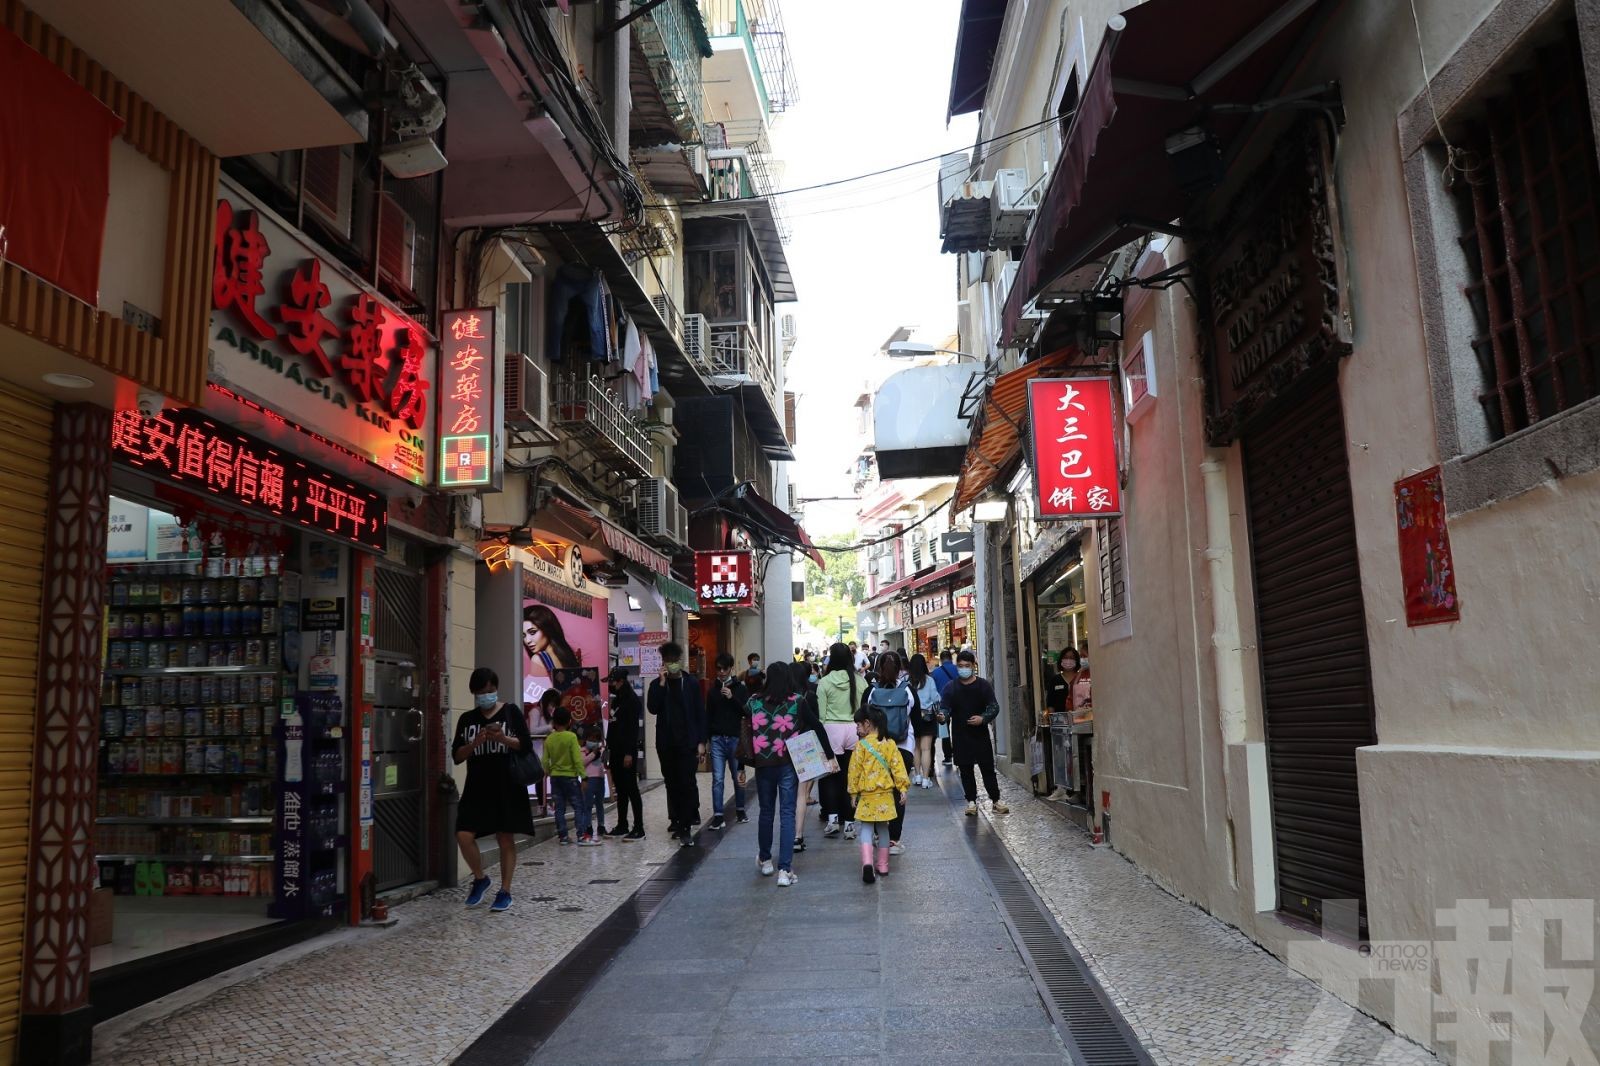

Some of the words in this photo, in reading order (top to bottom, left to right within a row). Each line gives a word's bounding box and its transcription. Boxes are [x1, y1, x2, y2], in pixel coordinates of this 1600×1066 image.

[208, 318, 347, 409] ARMÁCIA
[356, 404, 391, 433] KIN
[399, 429, 424, 451] ON
[451, 316, 485, 433] 健安藥房
[571, 695, 588, 721] 3
